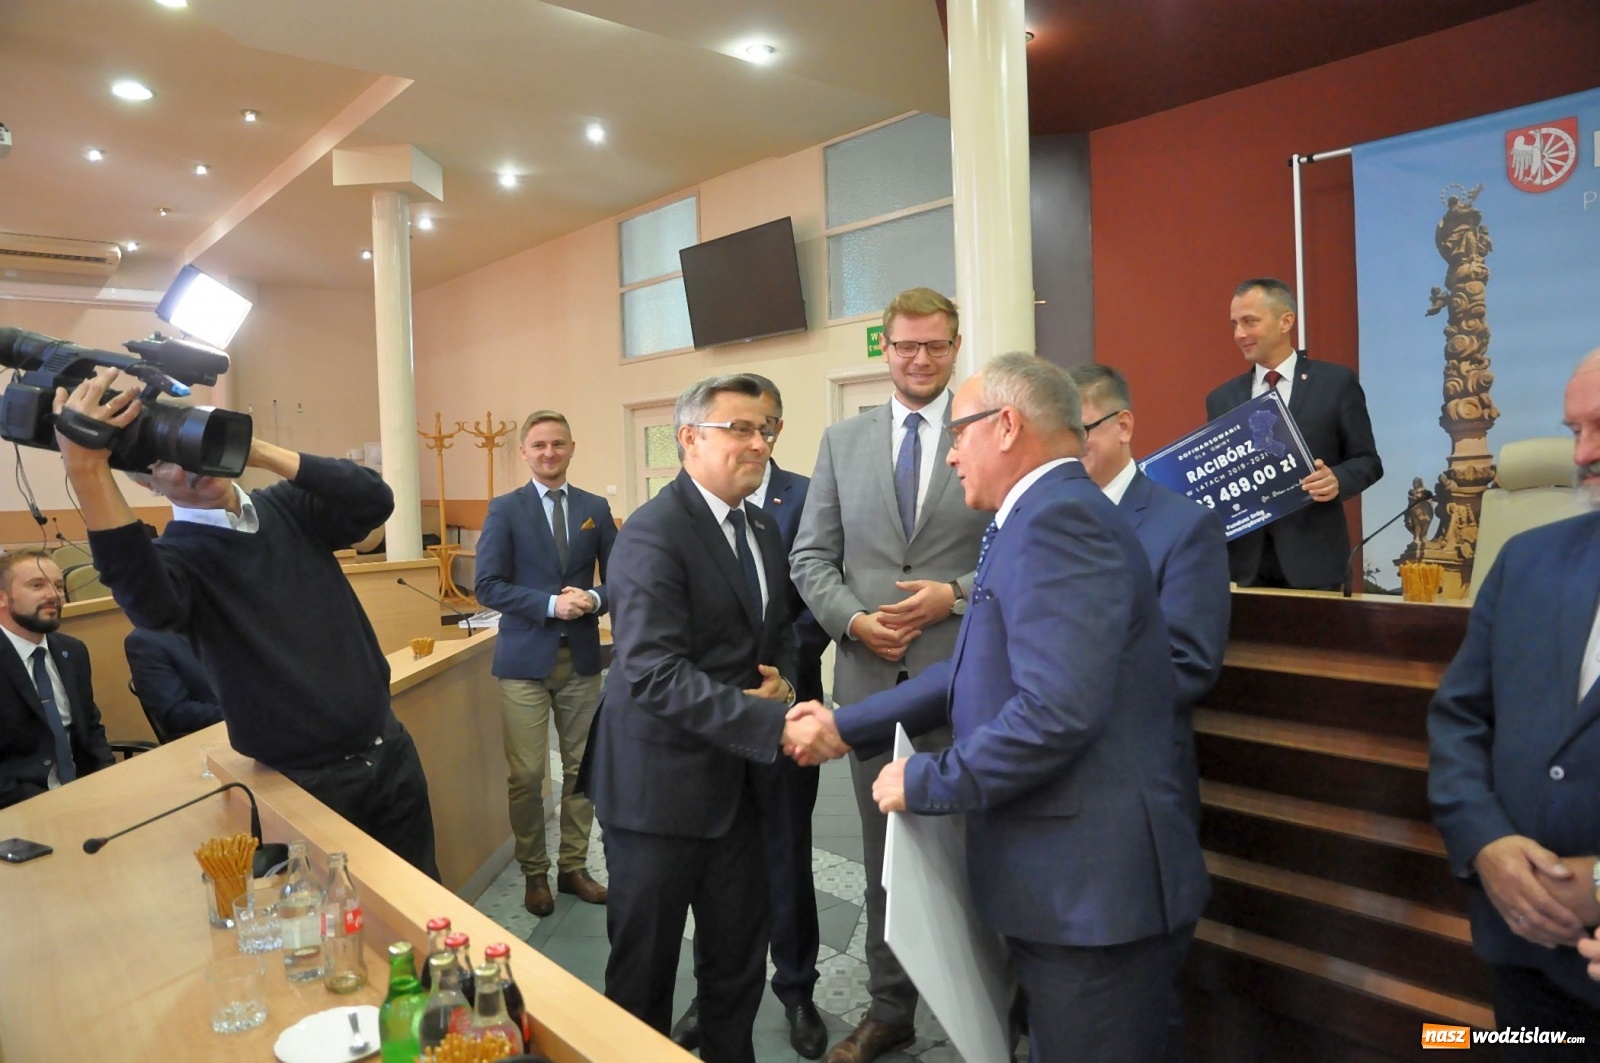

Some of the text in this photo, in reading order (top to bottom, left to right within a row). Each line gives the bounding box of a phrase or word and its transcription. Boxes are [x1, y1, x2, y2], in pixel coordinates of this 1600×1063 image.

[1177, 423, 1242, 461] DOFINANSOWANIE
[1185, 439, 1256, 483] RACIBÓRZ
[1194, 451, 1206, 460] DLA
[1195, 474, 1226, 493] LATACH
[1219, 464, 1277, 502] 489,00
[1279, 453, 1298, 473] zł
